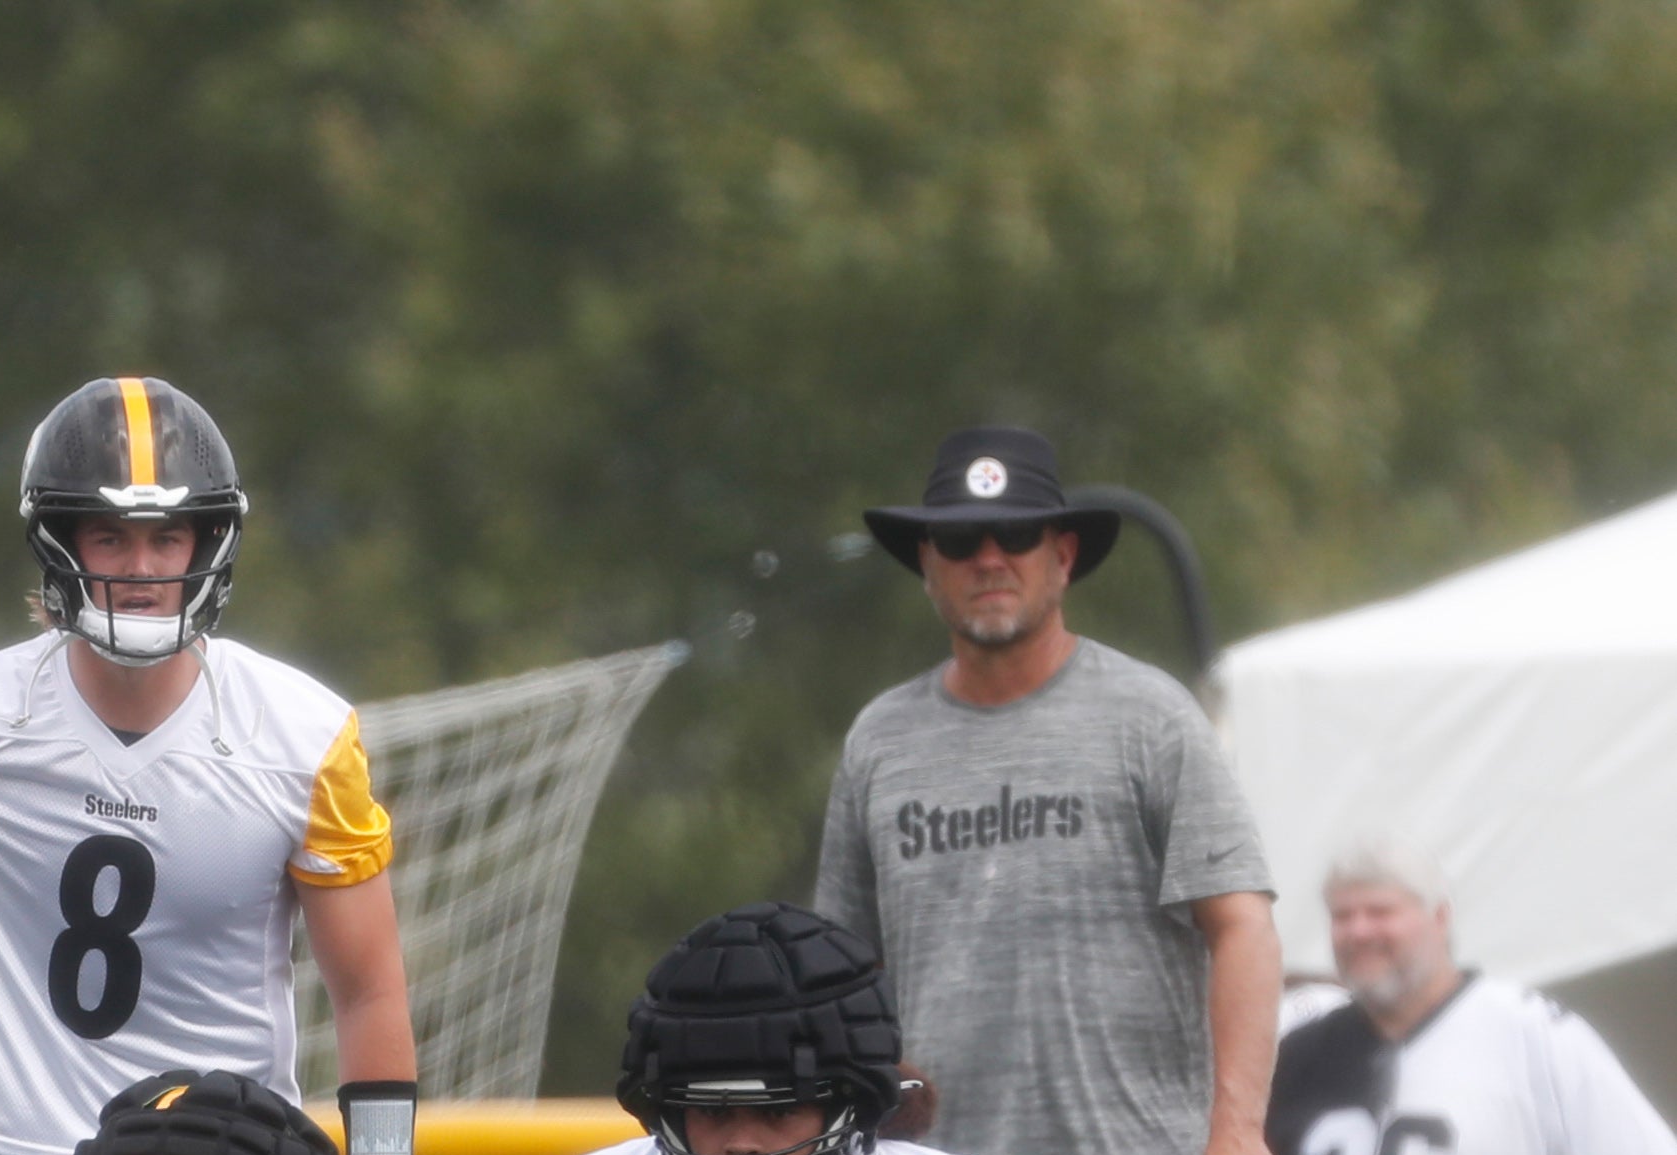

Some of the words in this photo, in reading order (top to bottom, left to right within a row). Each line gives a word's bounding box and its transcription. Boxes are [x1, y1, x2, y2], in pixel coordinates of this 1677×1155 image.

[85, 793, 157, 822] Steelers
[898, 785, 1083, 860] Steelers
[48, 834, 156, 1040] 8
